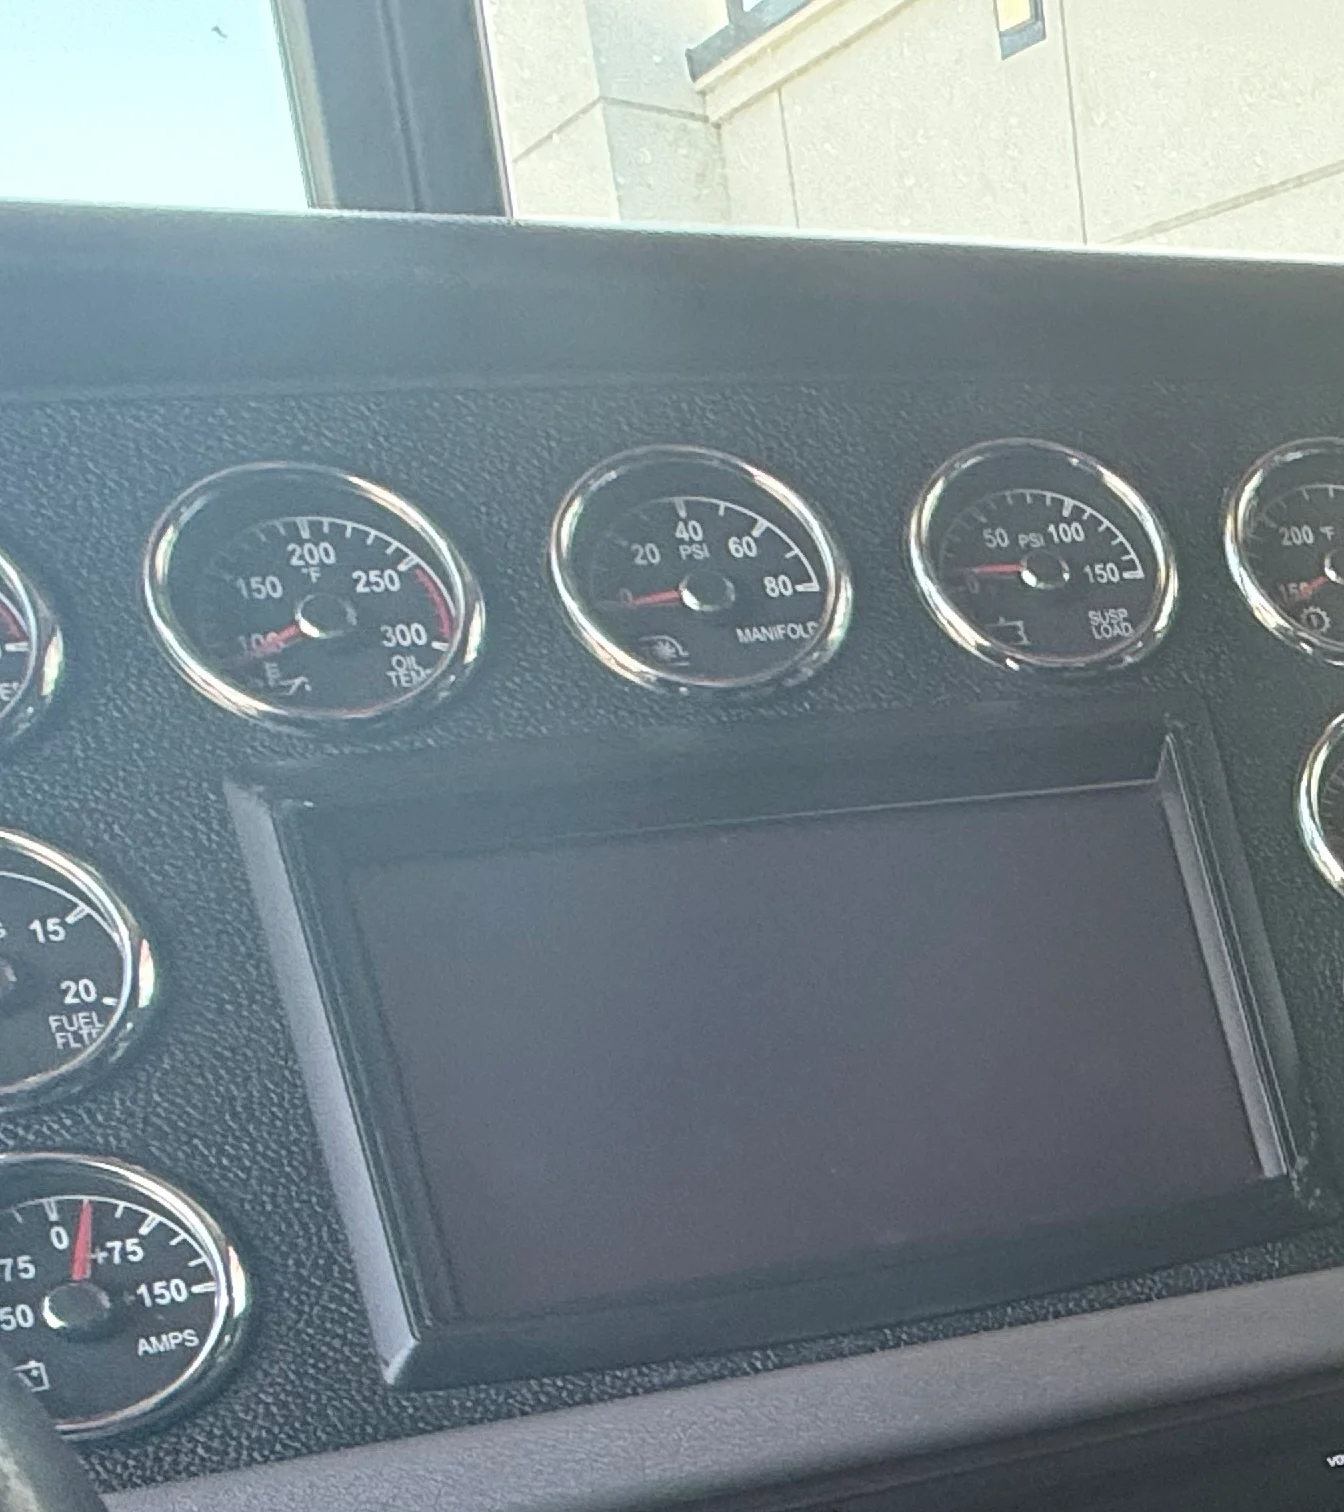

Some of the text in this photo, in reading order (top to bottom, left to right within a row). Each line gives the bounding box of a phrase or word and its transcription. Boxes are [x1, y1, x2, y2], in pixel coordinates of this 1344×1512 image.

[675, 521, 703, 543] 40
[983, 528, 1009, 548] 50
[1018, 533, 1045, 549] PSI
[1047, 522, 1085, 544] 100
[1278, 526, 1315, 546] 200
[286, 541, 336, 566] 200
[631, 543, 661, 566] 20
[679, 544, 710, 560] PSI
[728, 536, 758, 558] 60
[352, 569, 400, 593] 250
[1083, 563, 1121, 584] 150
[237, 576, 283, 600] 150
[763, 574, 794, 598] 80
[1088, 608, 1129, 625] SUSP
[380, 622, 428, 648] 300
[1092, 622, 1134, 640] LOAD
[391, 654, 422, 671] OIL
[29, 917, 66, 944] 15
[60, 978, 97, 1005] 20
[49, 1011, 104, 1034] FUEL
[50, 1226, 69, 1250] 0
[137, 1328, 200, 1357] AMPS
